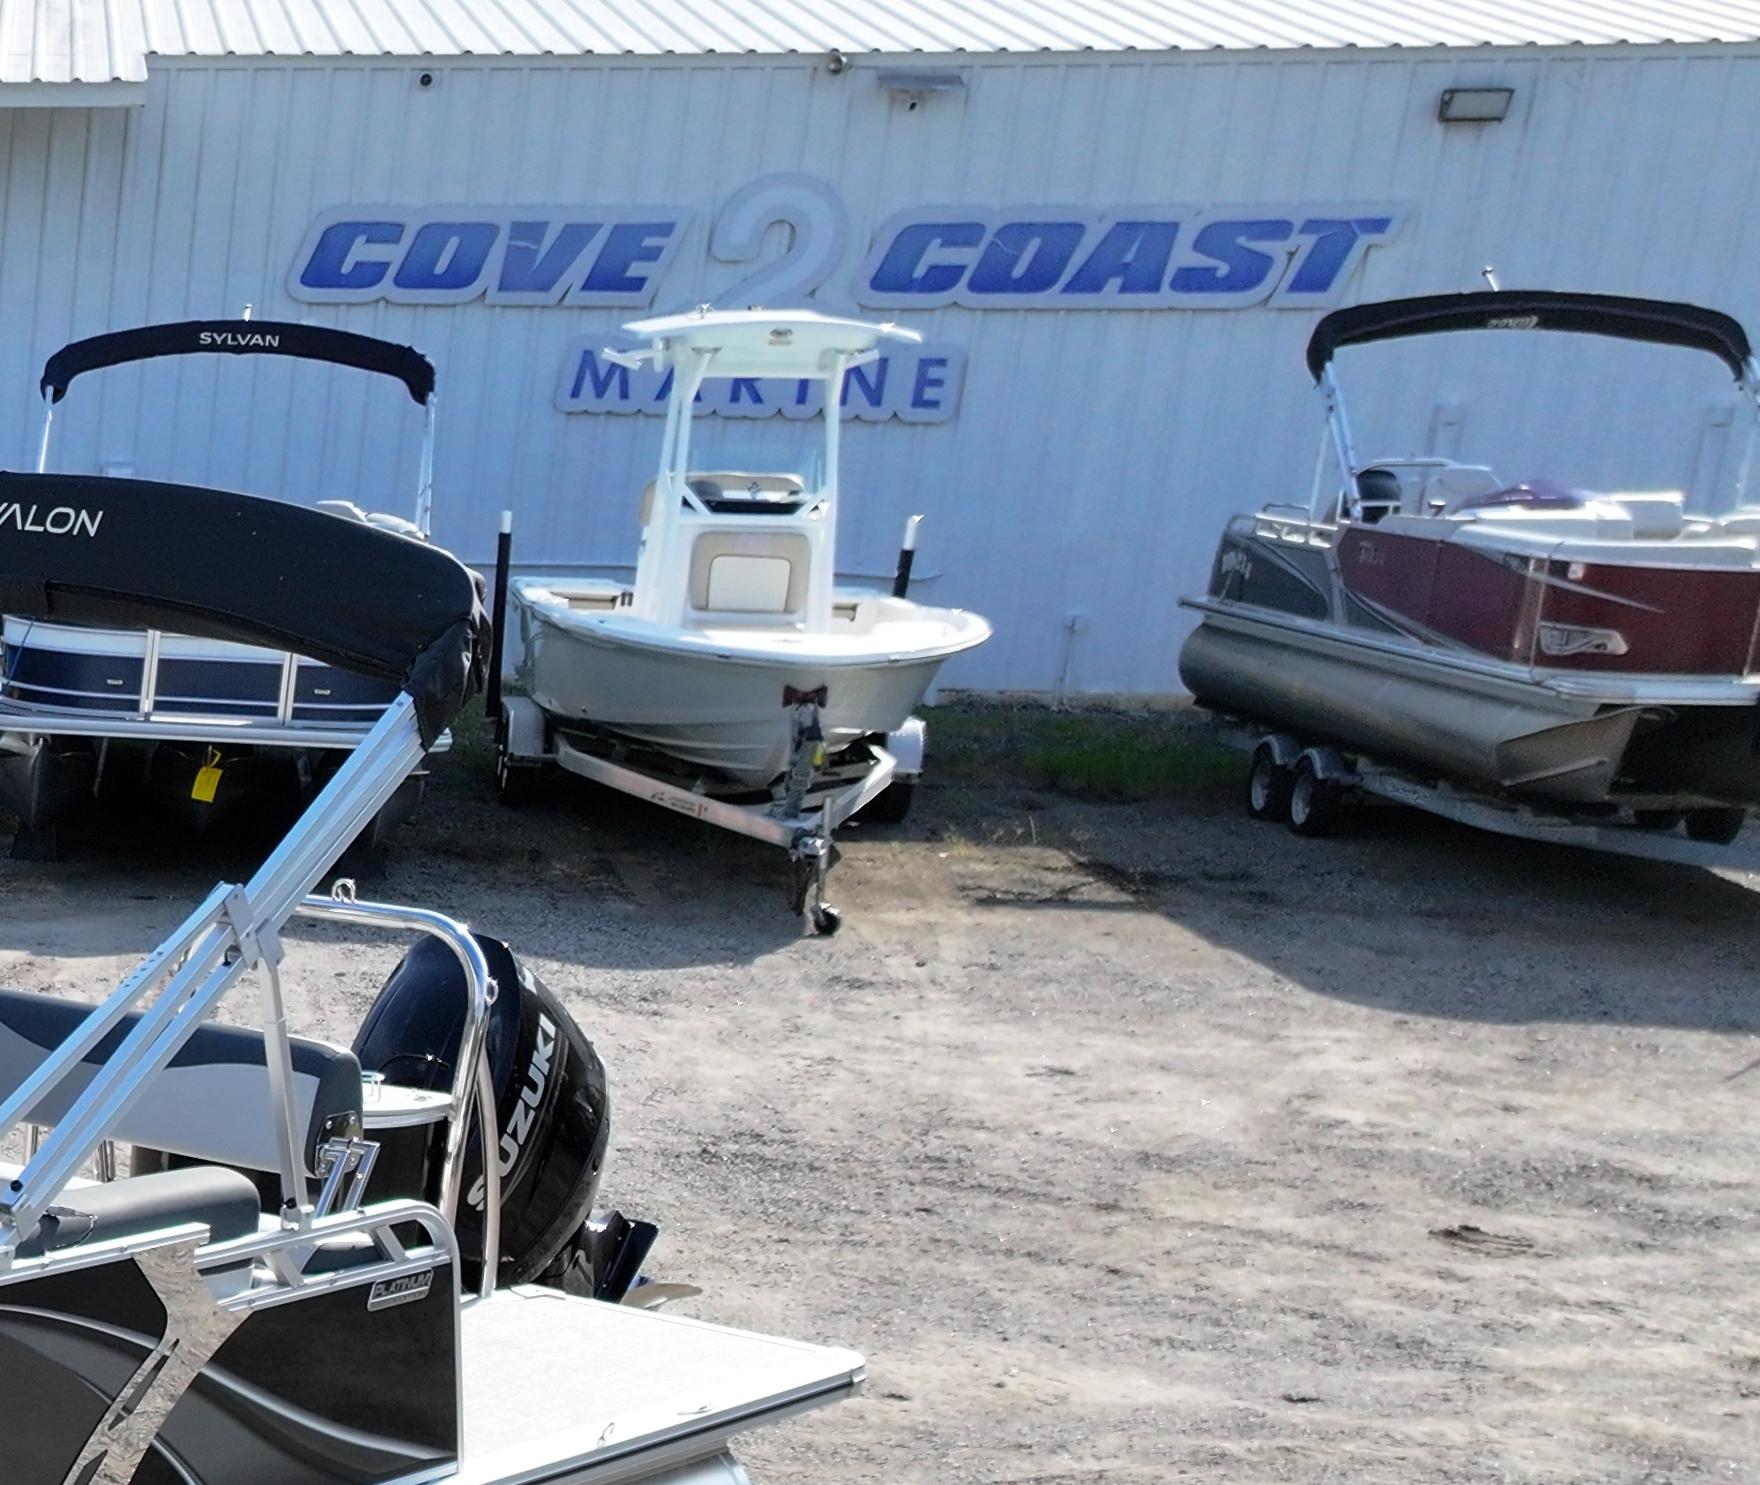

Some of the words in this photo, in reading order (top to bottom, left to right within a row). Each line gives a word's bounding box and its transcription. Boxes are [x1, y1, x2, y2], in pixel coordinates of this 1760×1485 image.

[299, 219, 677, 293] COVE
[695, 172, 850, 311] 2
[869, 216, 1395, 295] COAST
[199, 331, 280, 348] SYLVAN
[375, 1272, 432, 1297] PLATINUM
